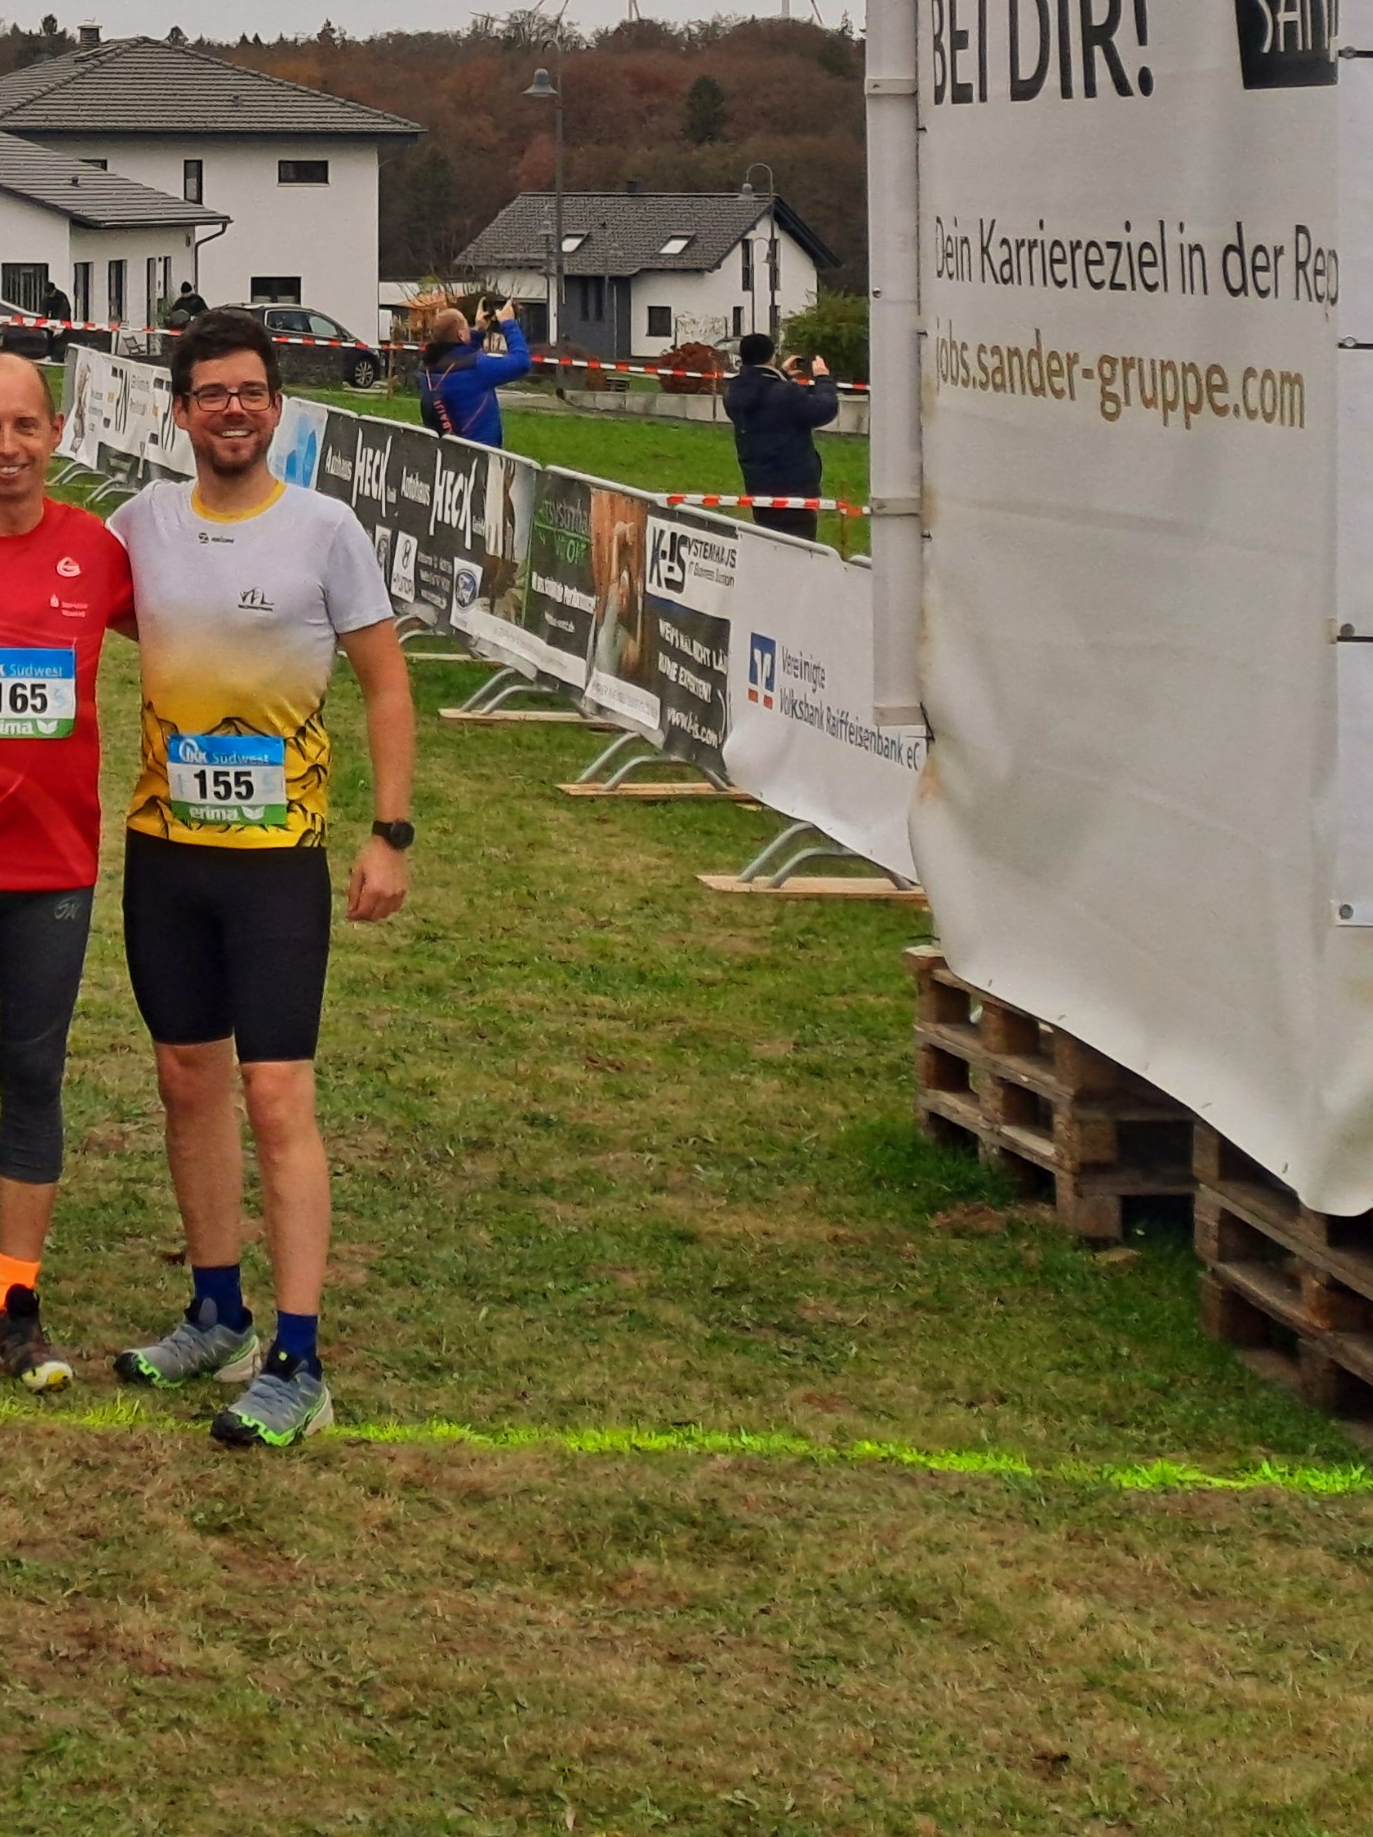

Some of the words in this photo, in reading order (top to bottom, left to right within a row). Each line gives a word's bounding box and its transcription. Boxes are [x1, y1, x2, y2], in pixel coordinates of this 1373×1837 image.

[935, 215, 972, 283] Dein
[980, 217, 1168, 293] Karriereziel
[1179, 220, 1208, 296] in
[1222, 220, 1285, 300] der
[936, 318, 1305, 430] jobs.sander-gruppe.com
[351, 427, 393, 518] HECK
[429, 448, 478, 551] HECK
[10, 663, 62, 677] Südwest
[781, 646, 825, 693] Vereinigte
[780, 687, 824, 730] Volksbank
[826, 706, 904, 765] Raiffeisenbank
[189, 807, 240, 821] erima
[193, 769, 254, 800] 155
